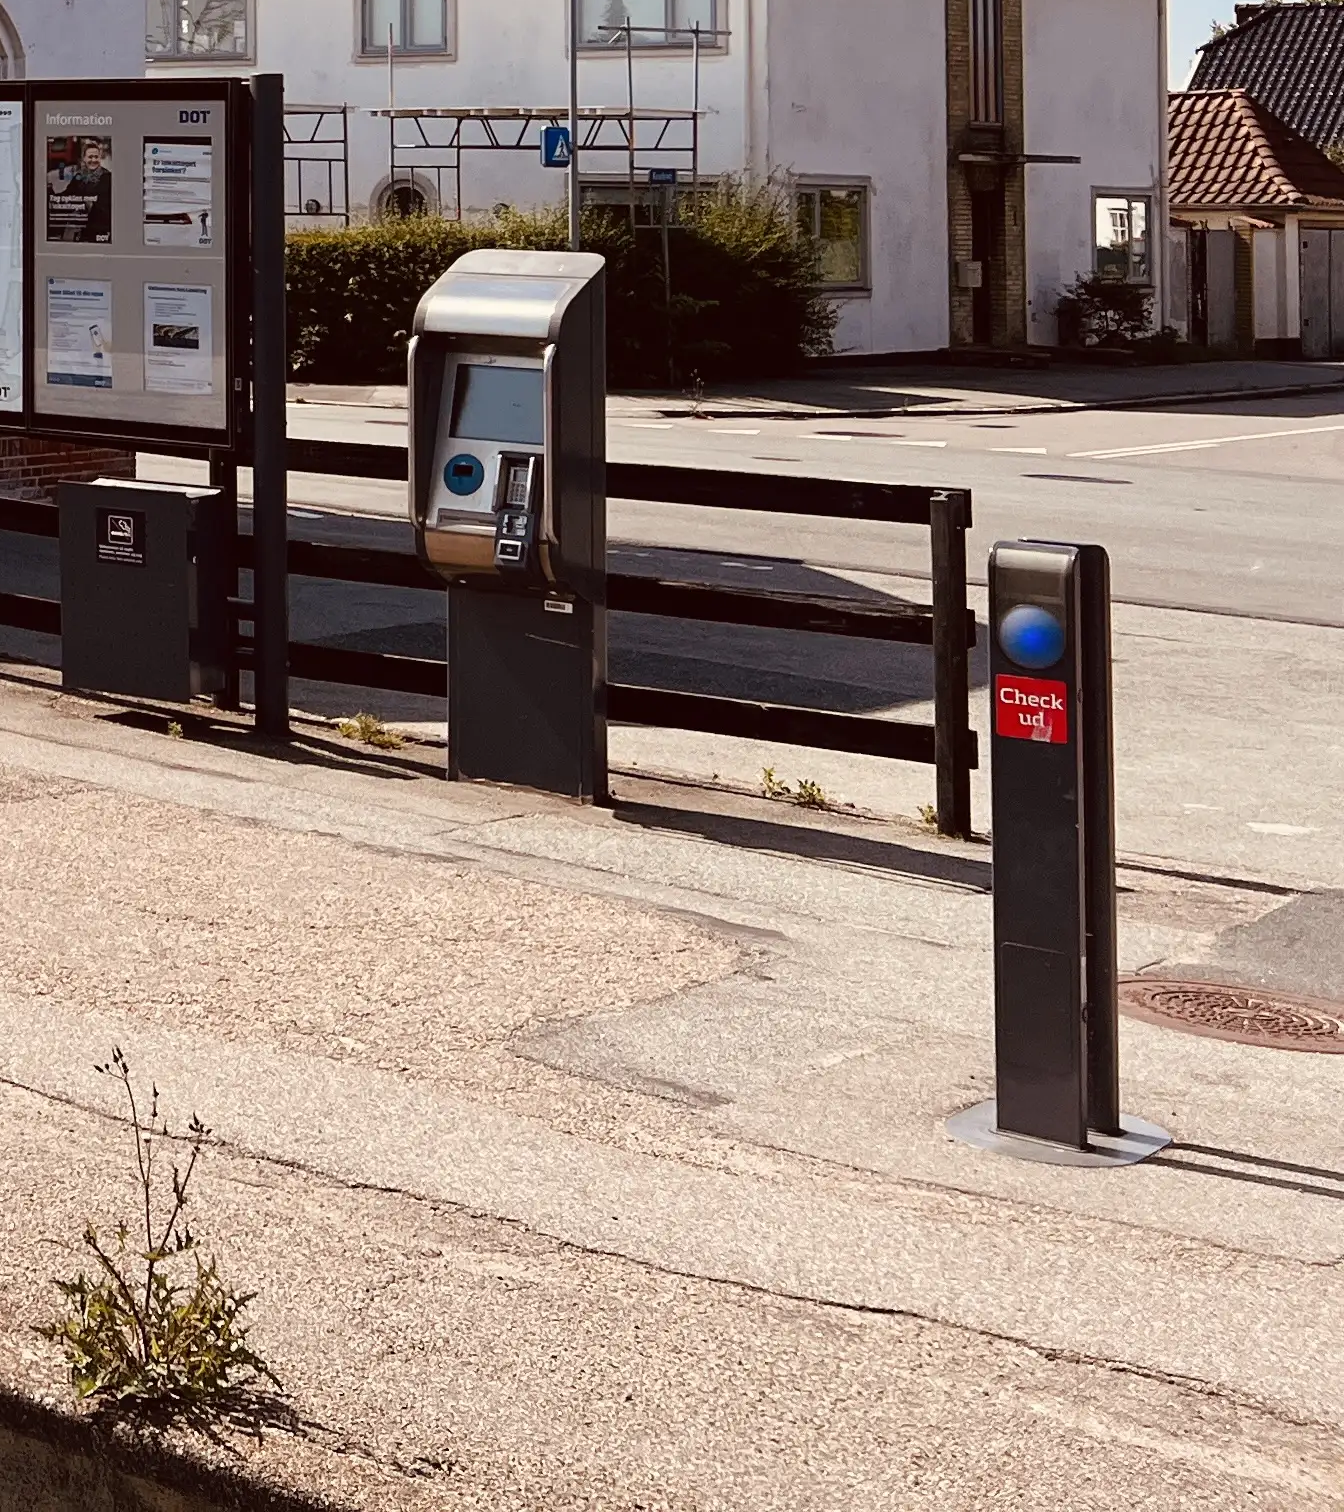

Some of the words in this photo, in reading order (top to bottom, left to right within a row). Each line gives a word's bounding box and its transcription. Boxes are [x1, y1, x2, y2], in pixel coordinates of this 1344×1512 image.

[45, 113, 113, 126] Information
[179, 109, 208, 124] DOT
[999, 687, 1064, 711] Check
[1018, 711, 1045, 727] ud
